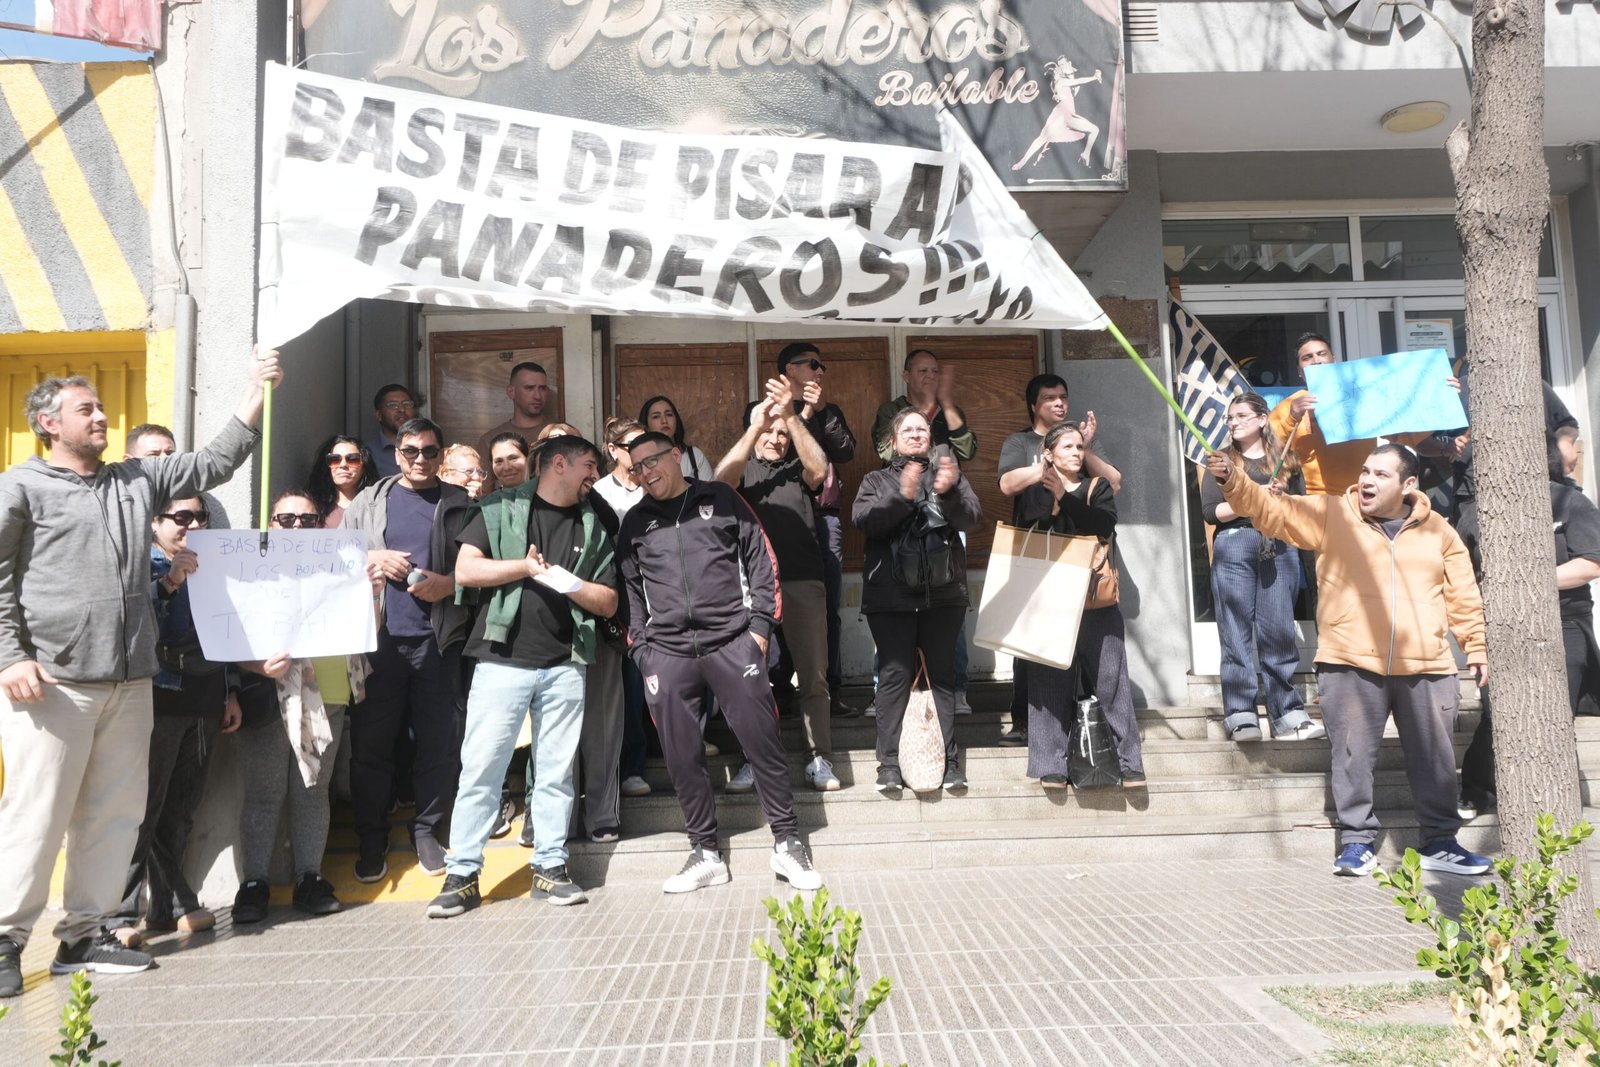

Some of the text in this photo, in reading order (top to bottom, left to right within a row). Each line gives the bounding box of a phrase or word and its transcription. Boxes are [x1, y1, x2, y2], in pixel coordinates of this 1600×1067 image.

[374, 0, 1030, 98] Los Panaderos
[874, 67, 1040, 107] Bailable
[285, 82, 540, 202] BASTA
[558, 130, 656, 213] DE
[673, 144, 882, 230] PISAR
[282, 537, 305, 553] DE
